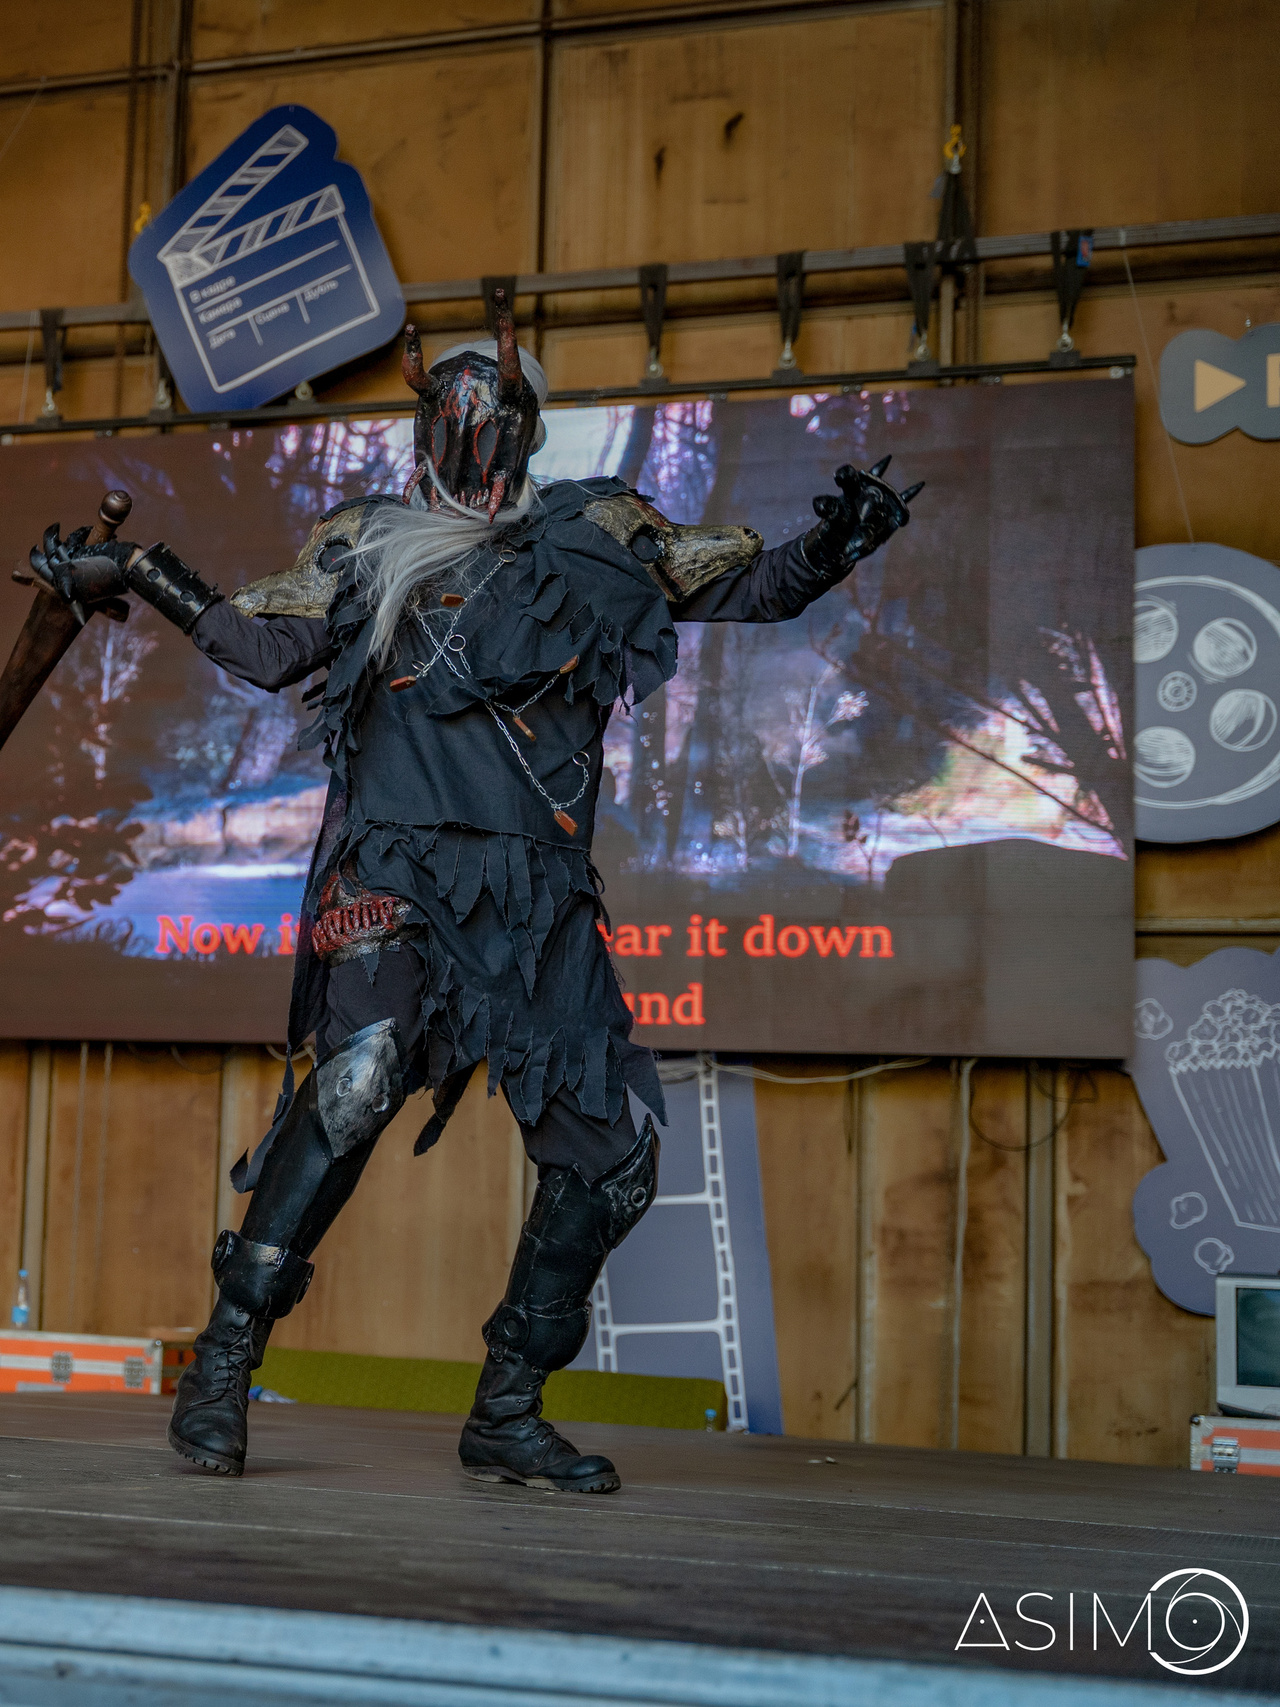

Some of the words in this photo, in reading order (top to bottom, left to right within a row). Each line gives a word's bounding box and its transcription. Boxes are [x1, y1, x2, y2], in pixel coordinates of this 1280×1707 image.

[155, 914, 265, 955] Now
[687, 914, 729, 957] it
[743, 914, 895, 958] down
